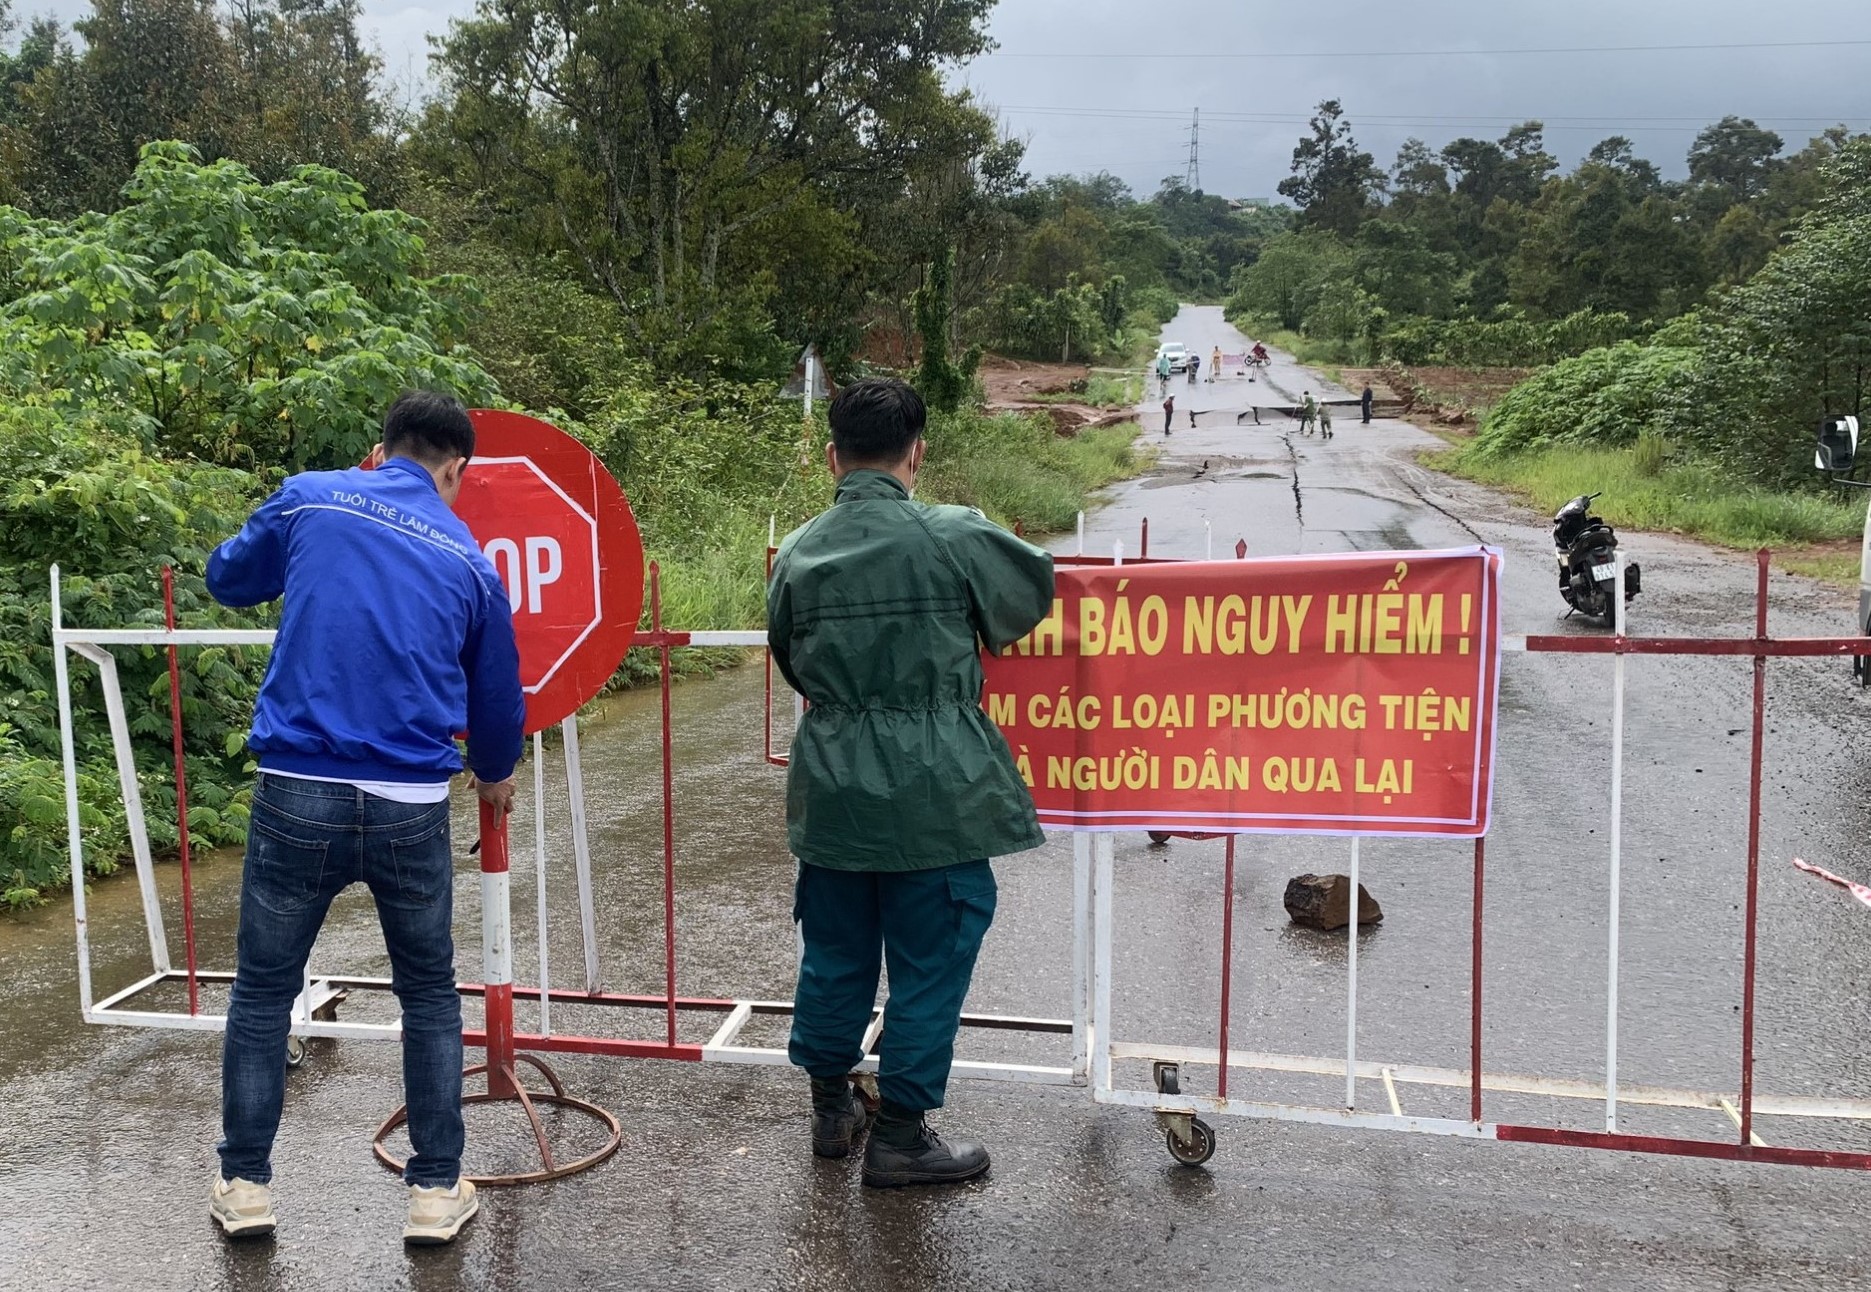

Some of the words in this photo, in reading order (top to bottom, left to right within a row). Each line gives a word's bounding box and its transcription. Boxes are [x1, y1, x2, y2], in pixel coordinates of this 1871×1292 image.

[475, 536, 562, 615] OP
[1079, 579, 1168, 656] BÁO
[1182, 594, 1313, 655] NGUY
[1324, 561, 1444, 655] HIỂM
[1027, 685, 1101, 731] CÁC
[1112, 693, 1195, 738] LOẠI
[1207, 687, 1367, 731] PHƯƠNG
[1379, 687, 1471, 741] TIỆN
[1016, 744, 1035, 787] À
[1047, 746, 1160, 790] NGƯỜI
[1173, 747, 1250, 790] DÂN
[1262, 756, 1342, 794] QUA
[1355, 758, 1413, 804] LẠI
